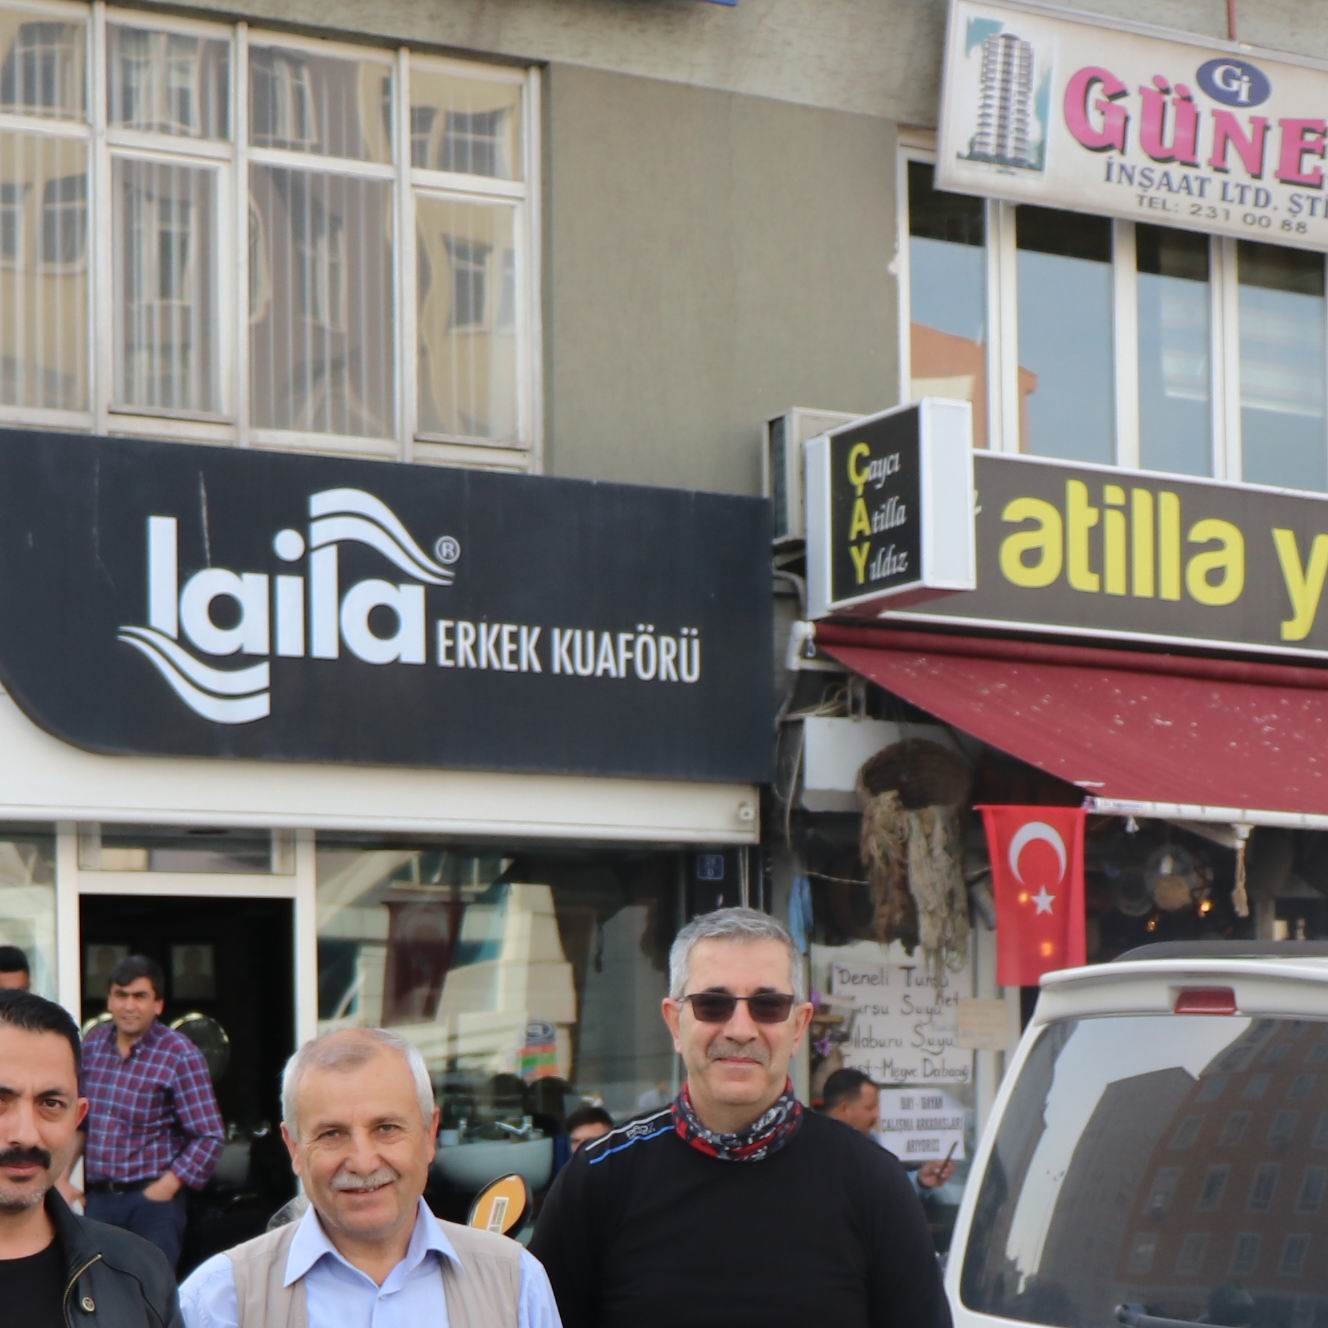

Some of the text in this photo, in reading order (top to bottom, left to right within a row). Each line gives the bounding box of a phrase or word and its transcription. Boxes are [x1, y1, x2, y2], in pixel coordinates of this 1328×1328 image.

[1105, 159, 1212, 198] İNŞAAT
[1222, 181, 1279, 212] LTD.
[1136, 194, 1180, 214] TEL:
[1189, 204, 1231, 222] 231
[1280, 218, 1308, 234] 88
[998, 478, 1246, 607] atilla
[437, 618, 702, 683] ERKEK KUAFÖRÜ
